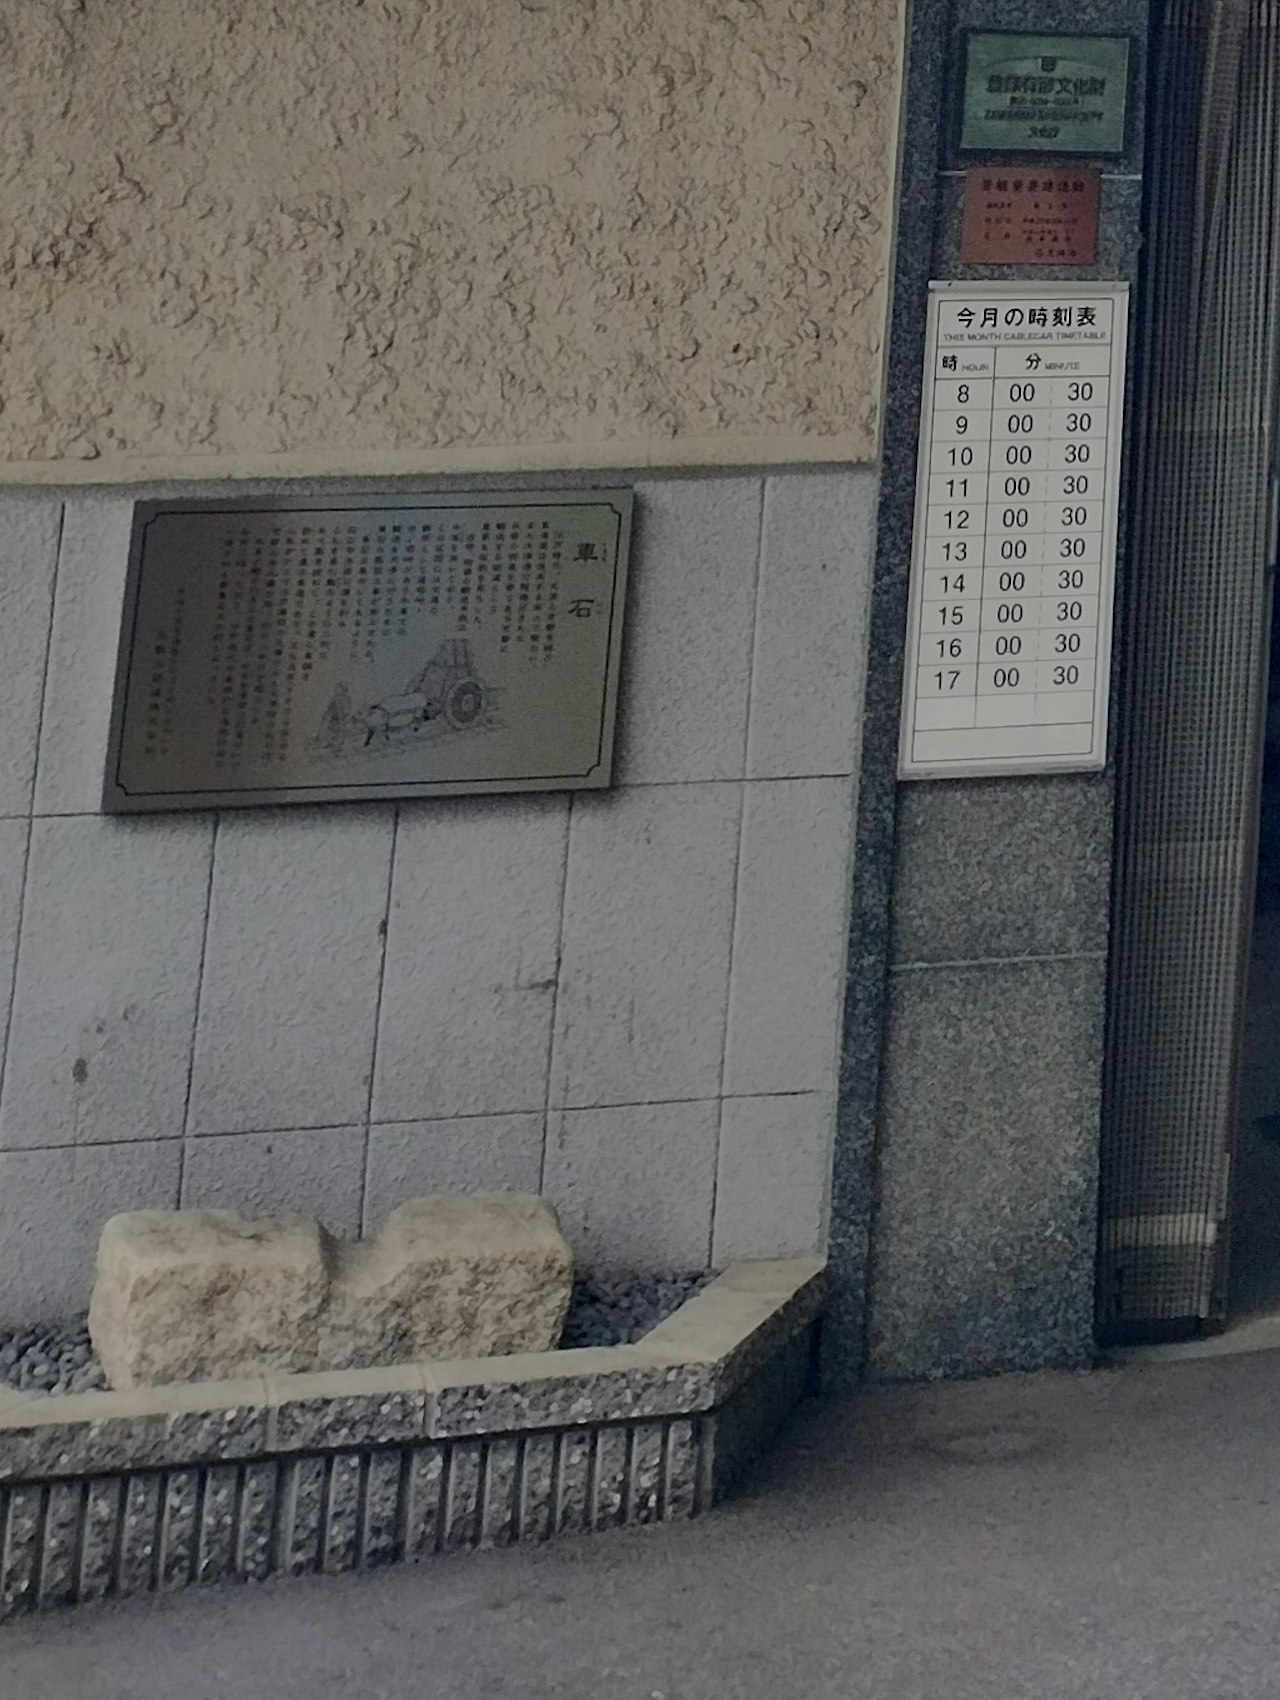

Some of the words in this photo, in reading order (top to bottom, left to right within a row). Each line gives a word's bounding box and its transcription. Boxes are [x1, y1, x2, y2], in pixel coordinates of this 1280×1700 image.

[957, 307, 1097, 328] 今月の時刻表
[967, 332, 1001, 342] MONTH
[942, 355, 958, 372] 時
[1025, 353, 1042, 370] 分
[957, 384, 970, 403] 8
[1009, 383, 1035, 402] 00
[1067, 382, 1093, 401] 30
[956, 415, 968, 435] 9
[1008, 414, 1033, 434] 00
[1066, 413, 1092, 432] 30
[948, 447, 973, 466] 10
[1006, 445, 1032, 465] 00
[1064, 444, 1090, 463] 30
[946, 478, 968, 497] 11
[1004, 477, 1030, 496] 00
[1063, 475, 1088, 494] 30
[944, 510, 969, 529] 12
[1002, 508, 1028, 528] 00
[1061, 506, 1087, 526] 30
[942, 542, 967, 561] 13
[1001, 540, 1027, 559] 00
[1059, 538, 1085, 557] 30
[940, 574, 965, 593] 14
[999, 572, 1025, 591] 00
[1058, 570, 1083, 589] 30
[938, 606, 963, 625] 15
[997, 603, 1023, 623] 00
[1056, 601, 1082, 621] 30
[936, 638, 962, 657] 16
[995, 636, 1021, 655] 00
[1054, 633, 1080, 653] 30
[934, 670, 961, 690] 17
[993, 668, 1020, 687] 00
[1052, 665, 1079, 685] 30
